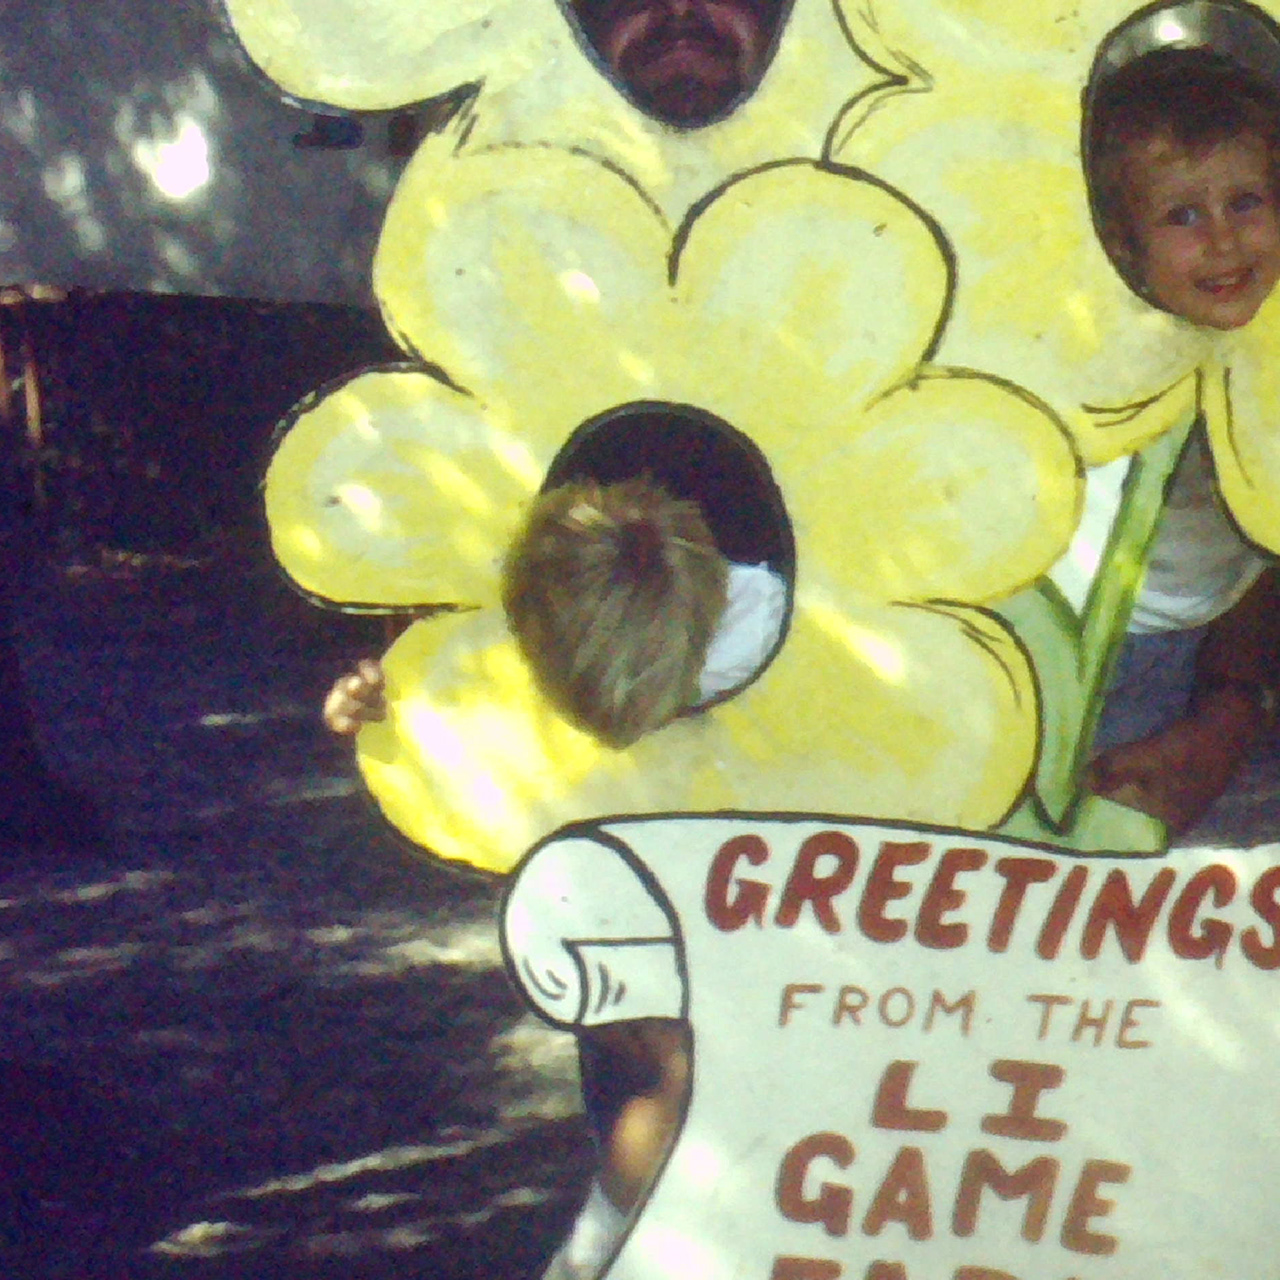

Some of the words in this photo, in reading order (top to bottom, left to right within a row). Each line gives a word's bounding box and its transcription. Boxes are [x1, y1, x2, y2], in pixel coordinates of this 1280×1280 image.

[777, 982, 979, 1039] FROM
[1025, 992, 1163, 1051] THE
[773, 1131, 1132, 1256] GAME
